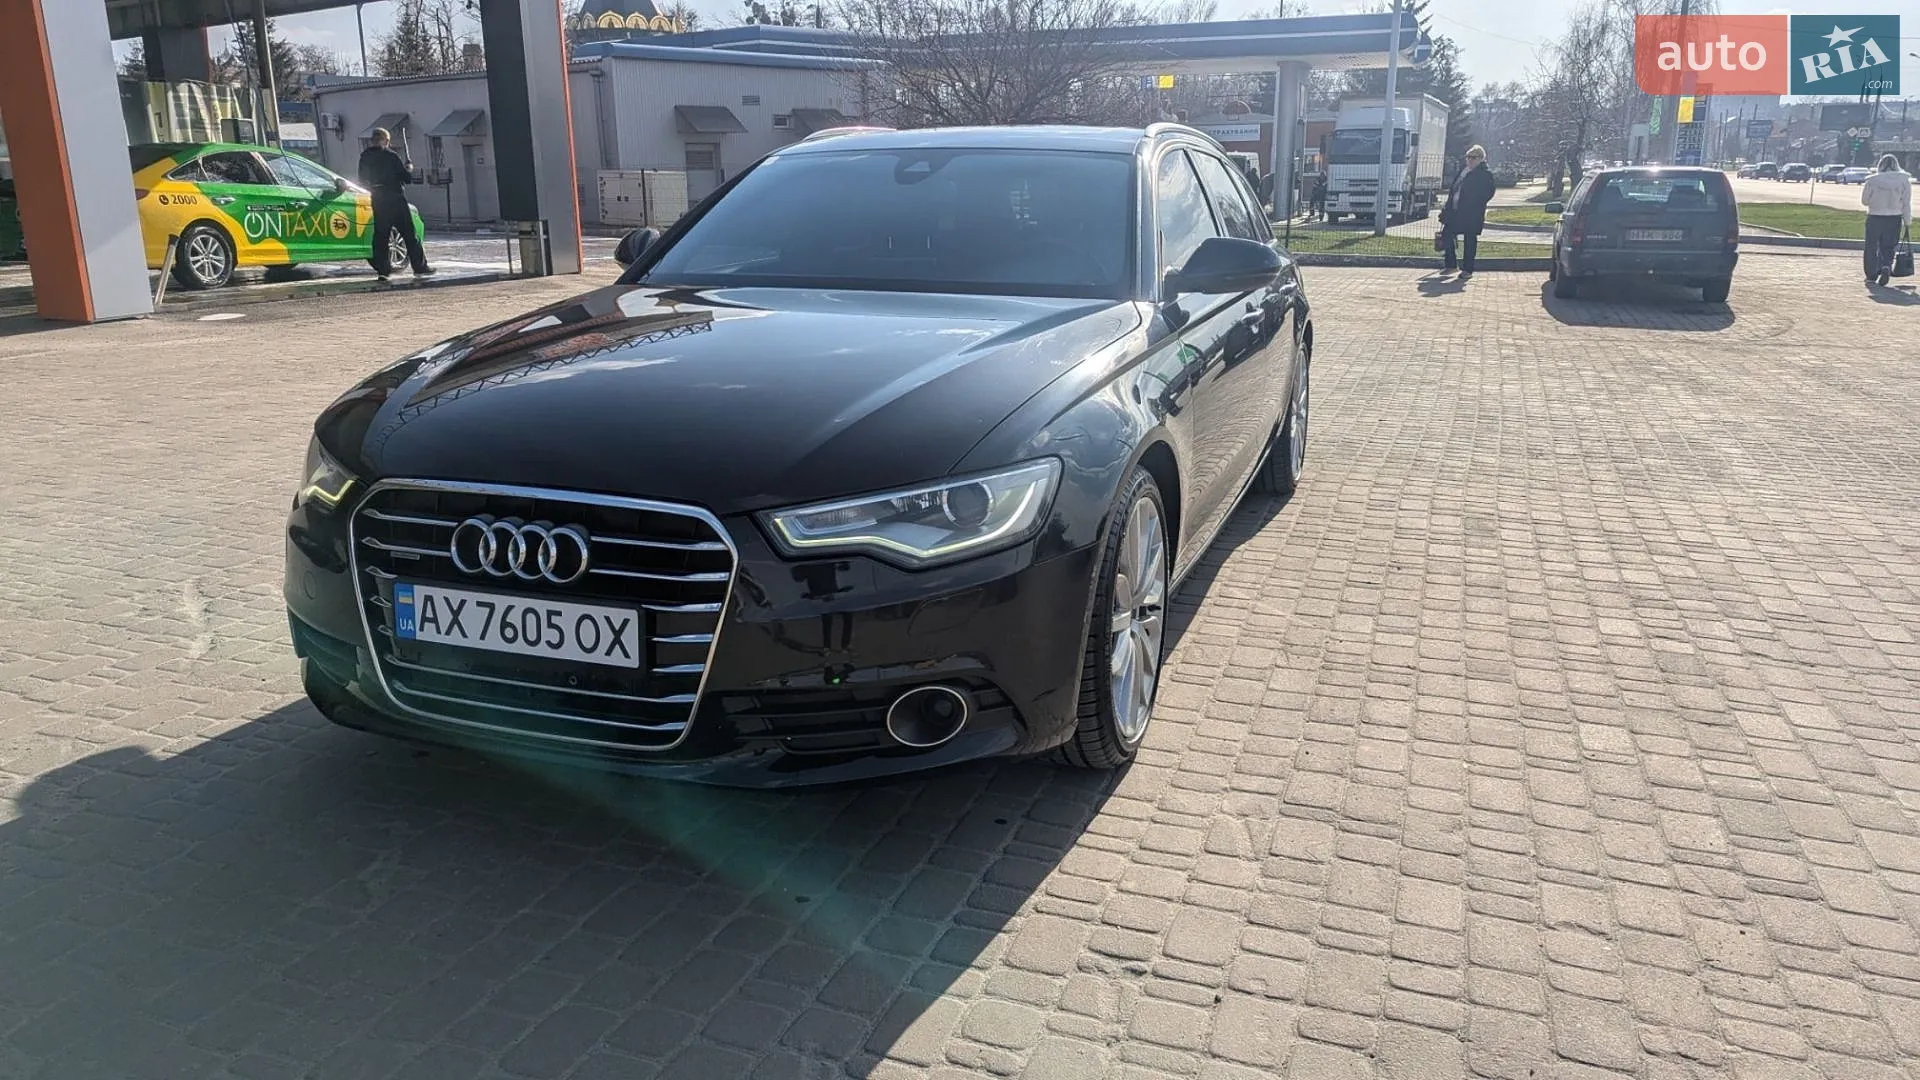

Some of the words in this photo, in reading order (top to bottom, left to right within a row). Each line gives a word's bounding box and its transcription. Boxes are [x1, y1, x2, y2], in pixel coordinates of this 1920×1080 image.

[172, 194, 198, 206] 2000
[400, 618, 415, 632] UA
[418, 594, 469, 639] AX
[475, 600, 565, 650] 7605
[574, 613, 632, 660] OX
